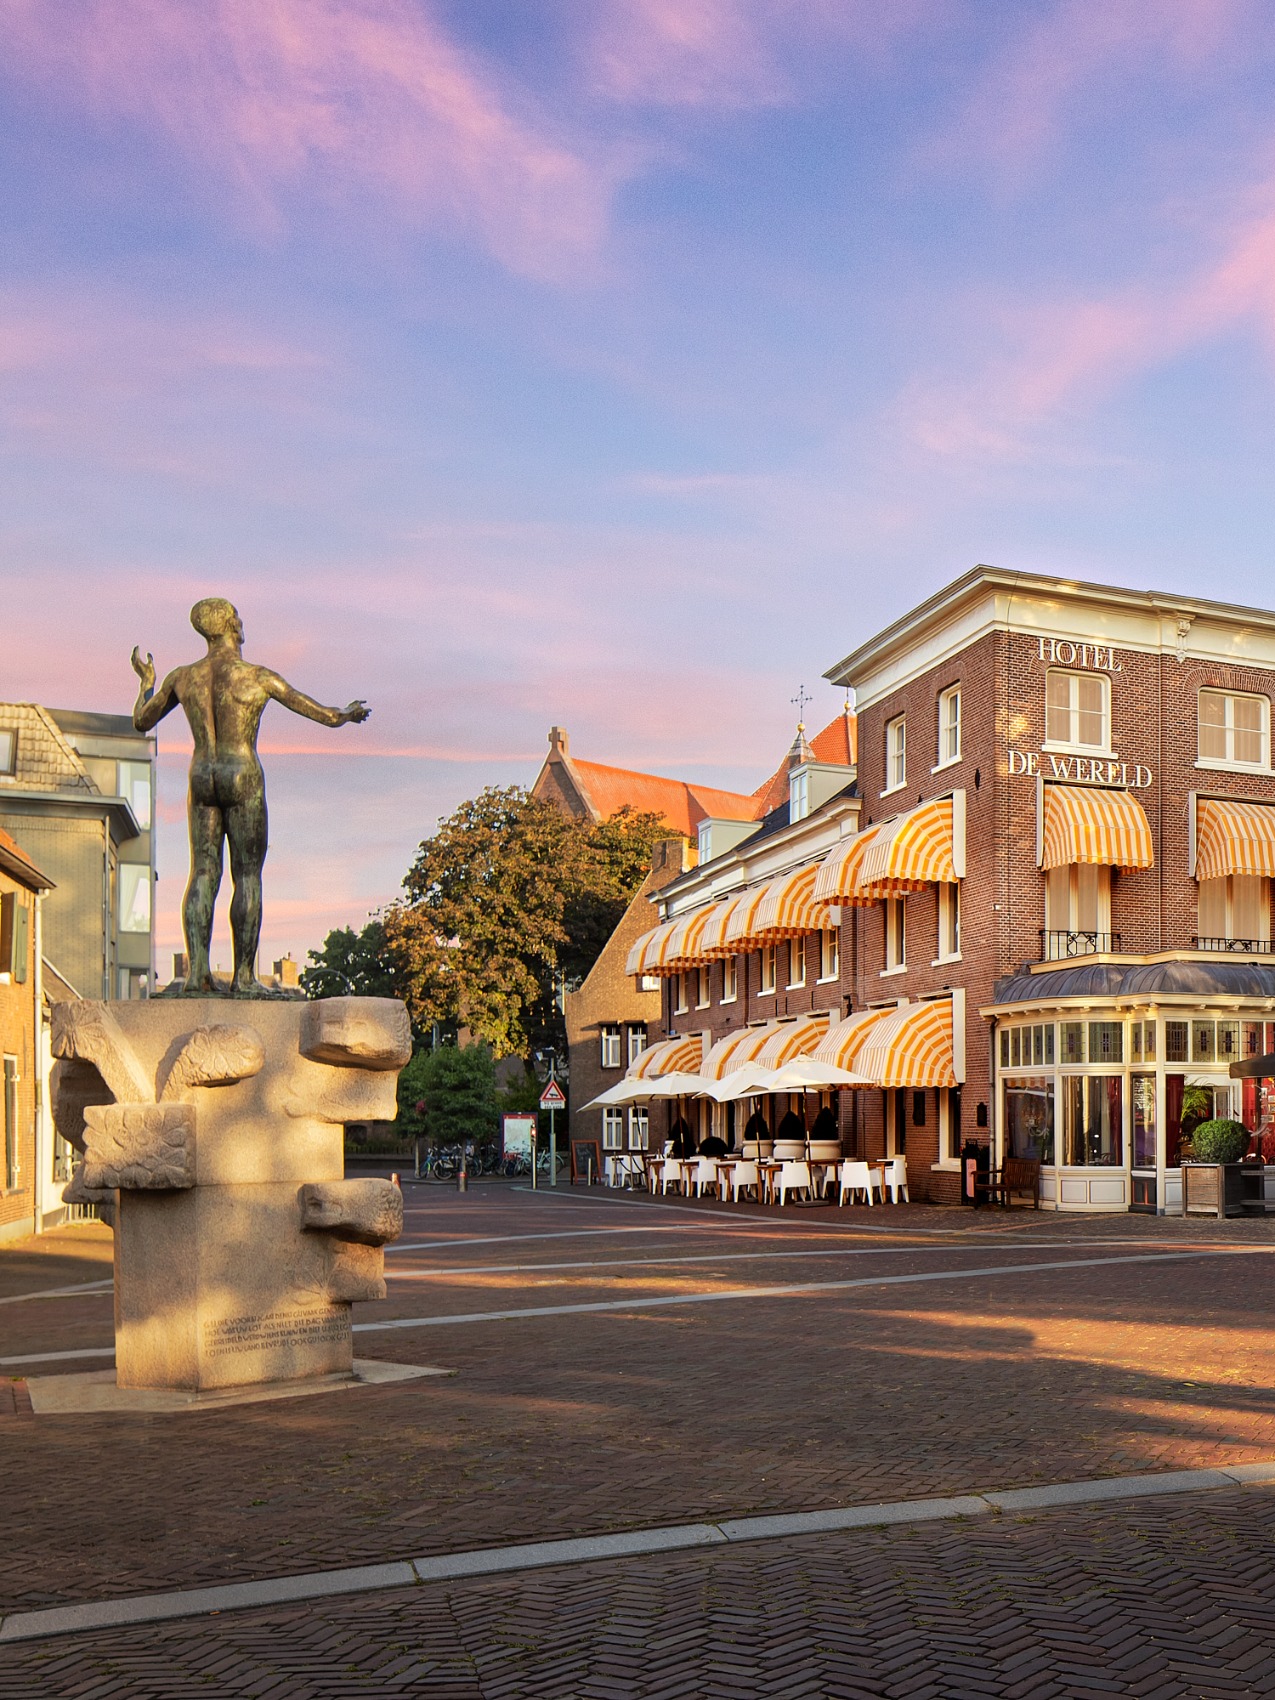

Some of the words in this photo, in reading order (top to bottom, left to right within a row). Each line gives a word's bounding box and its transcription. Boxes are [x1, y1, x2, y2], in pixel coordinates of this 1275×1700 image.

[1038, 638, 1122, 672] HOTEL
[1008, 750, 1041, 777] DE
[1048, 755, 1153, 788] WERELD
